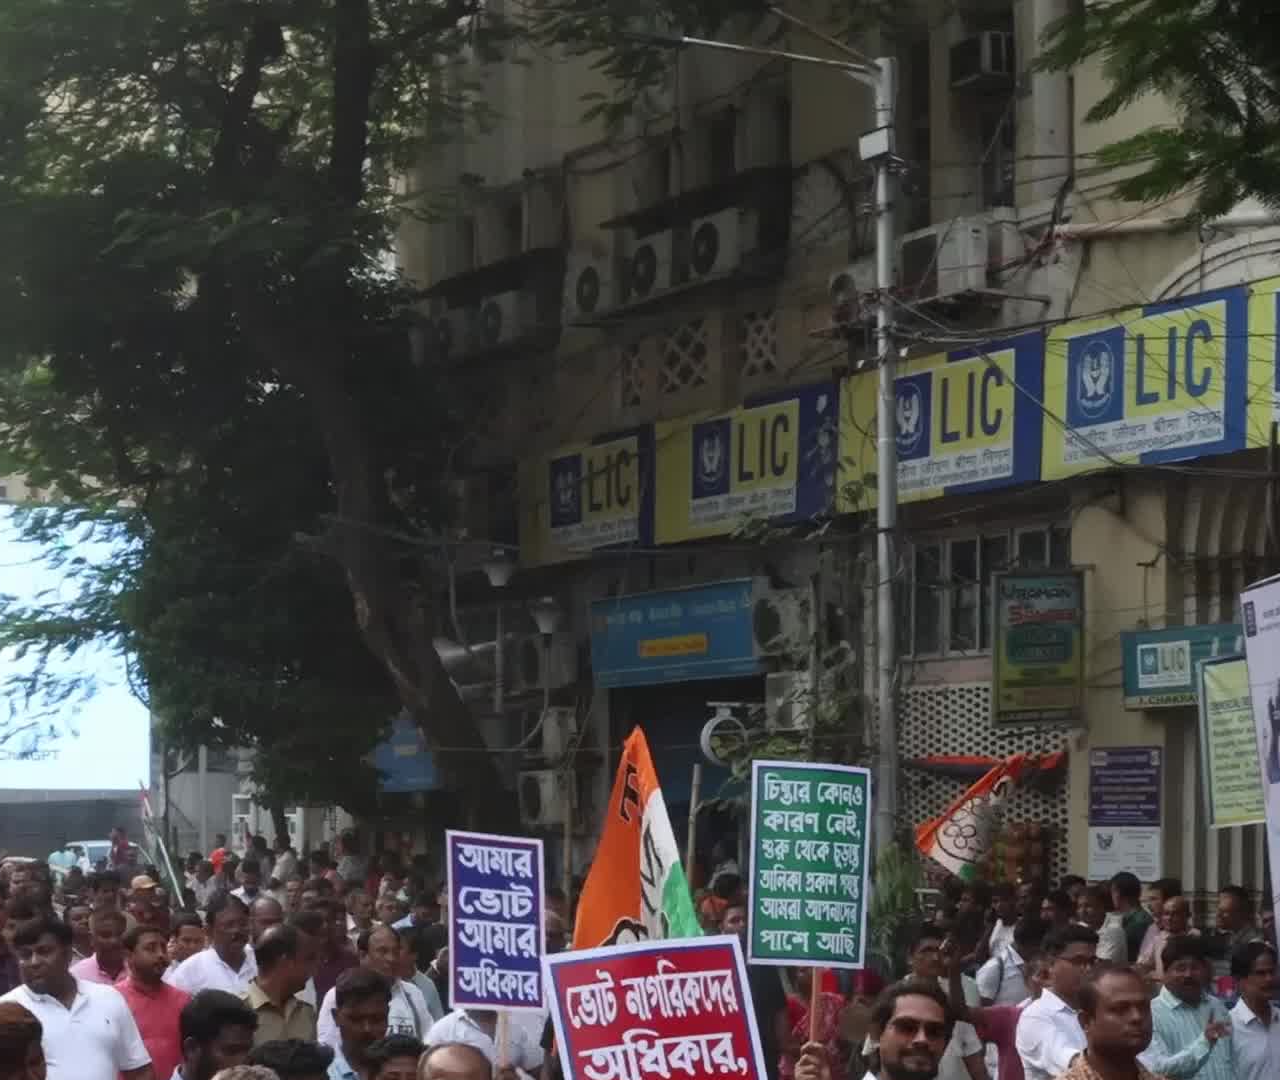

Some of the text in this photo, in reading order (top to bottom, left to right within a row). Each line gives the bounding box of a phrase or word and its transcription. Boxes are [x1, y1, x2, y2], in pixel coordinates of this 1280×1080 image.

[1135, 319, 1212, 406] LIC
[941, 366, 1004, 444] LIC
[738, 413, 789, 482] LIC
[588, 447, 632, 512] LIC
[1161, 646, 1185, 671] LIC
[1150, 692, 1197, 706] CHAKRA
[764, 773, 863, 807] চিন্তার কোনও
[763, 808, 861, 840] কারণ নেই,
[456, 842, 533, 879] আমার
[762, 839, 790, 861] শুরু
[794, 839, 830, 863] থেকে
[759, 863, 802, 892] তালিকা
[805, 871, 838, 895] প্রকাশ
[458, 882, 534, 917] ভোট
[759, 897, 857, 926] আমরা আপনাদের
[457, 917, 538, 958] আমার
[759, 927, 856, 958] পাশে আছি
[458, 959, 539, 1001] অধিকার
[567, 958, 739, 1029] ভোট নাগরিকদের
